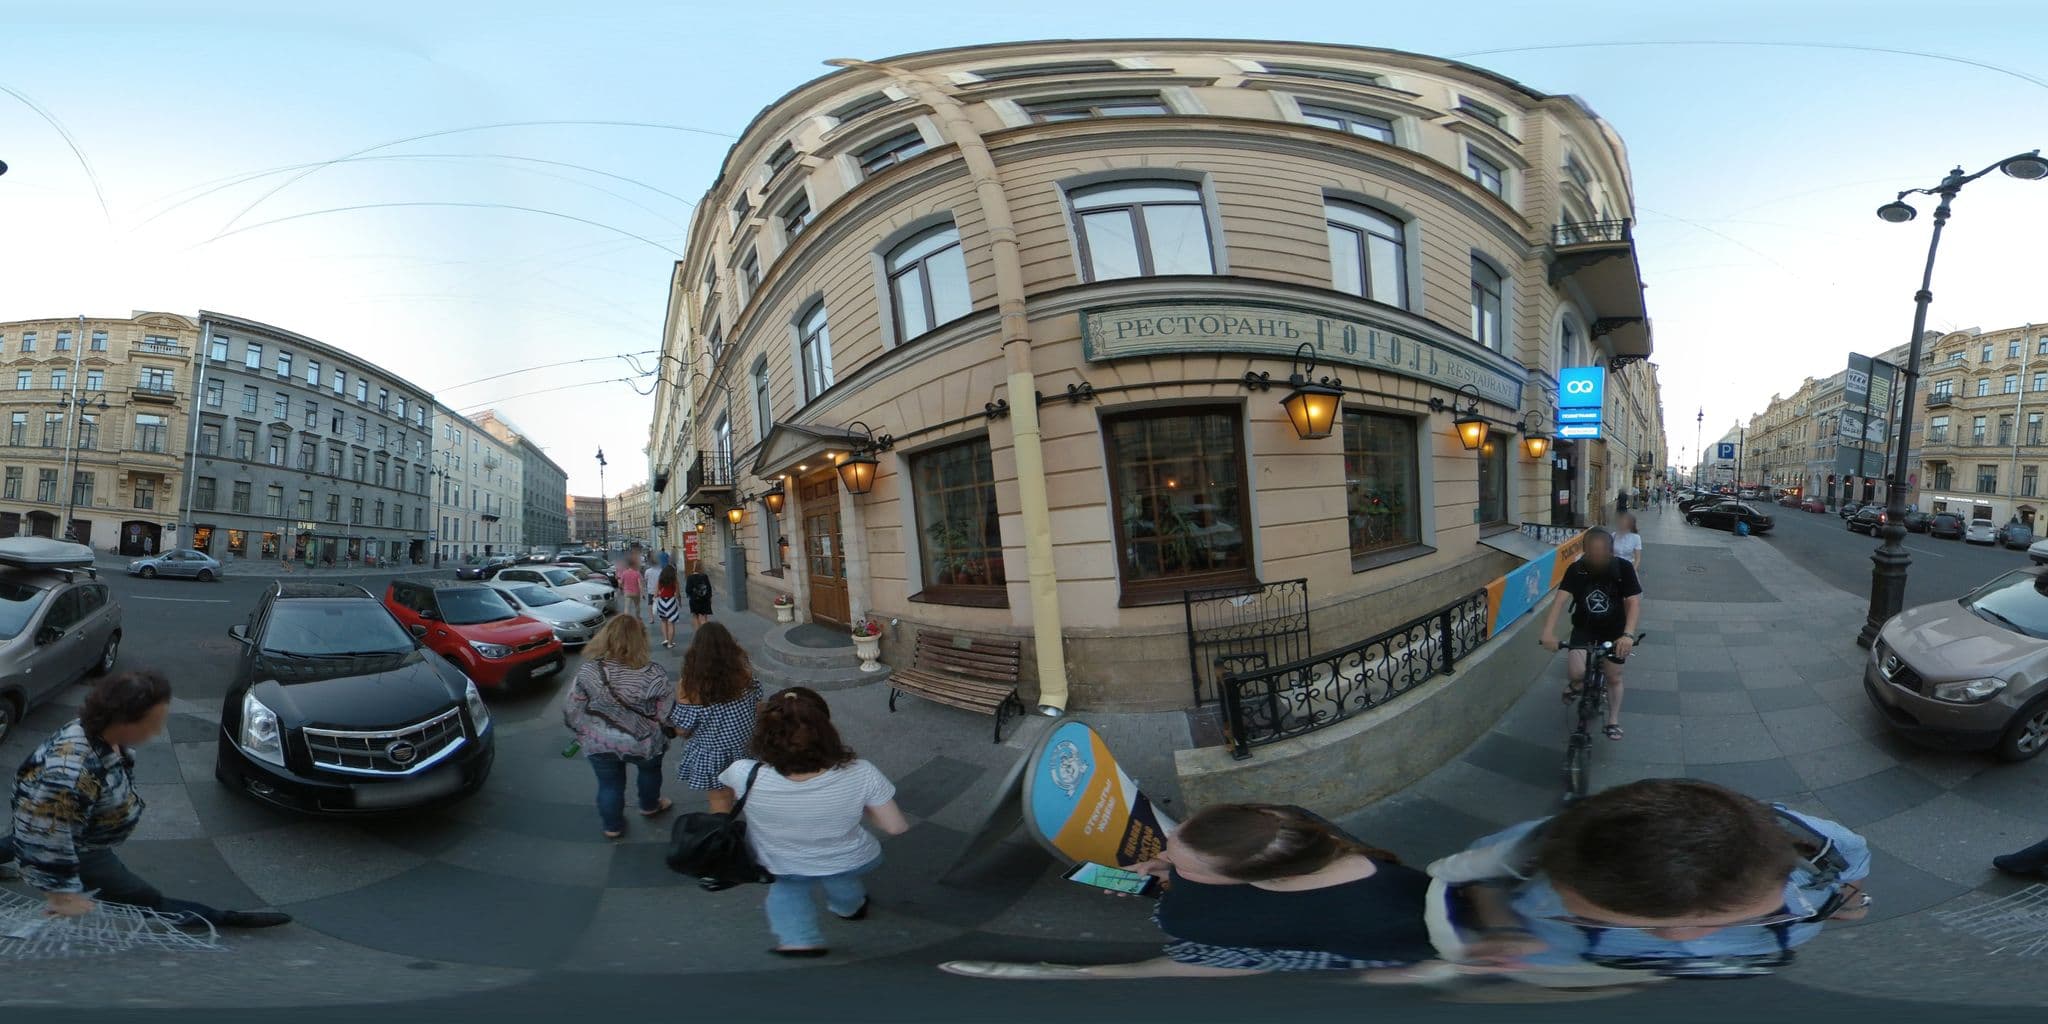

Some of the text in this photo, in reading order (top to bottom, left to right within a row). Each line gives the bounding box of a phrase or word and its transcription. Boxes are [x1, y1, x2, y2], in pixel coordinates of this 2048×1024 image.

[1114, 316, 1439, 376] РЕСТОРАНЪ ГОГОЛЬ
[1447, 359, 1515, 398] RESTAURANT
